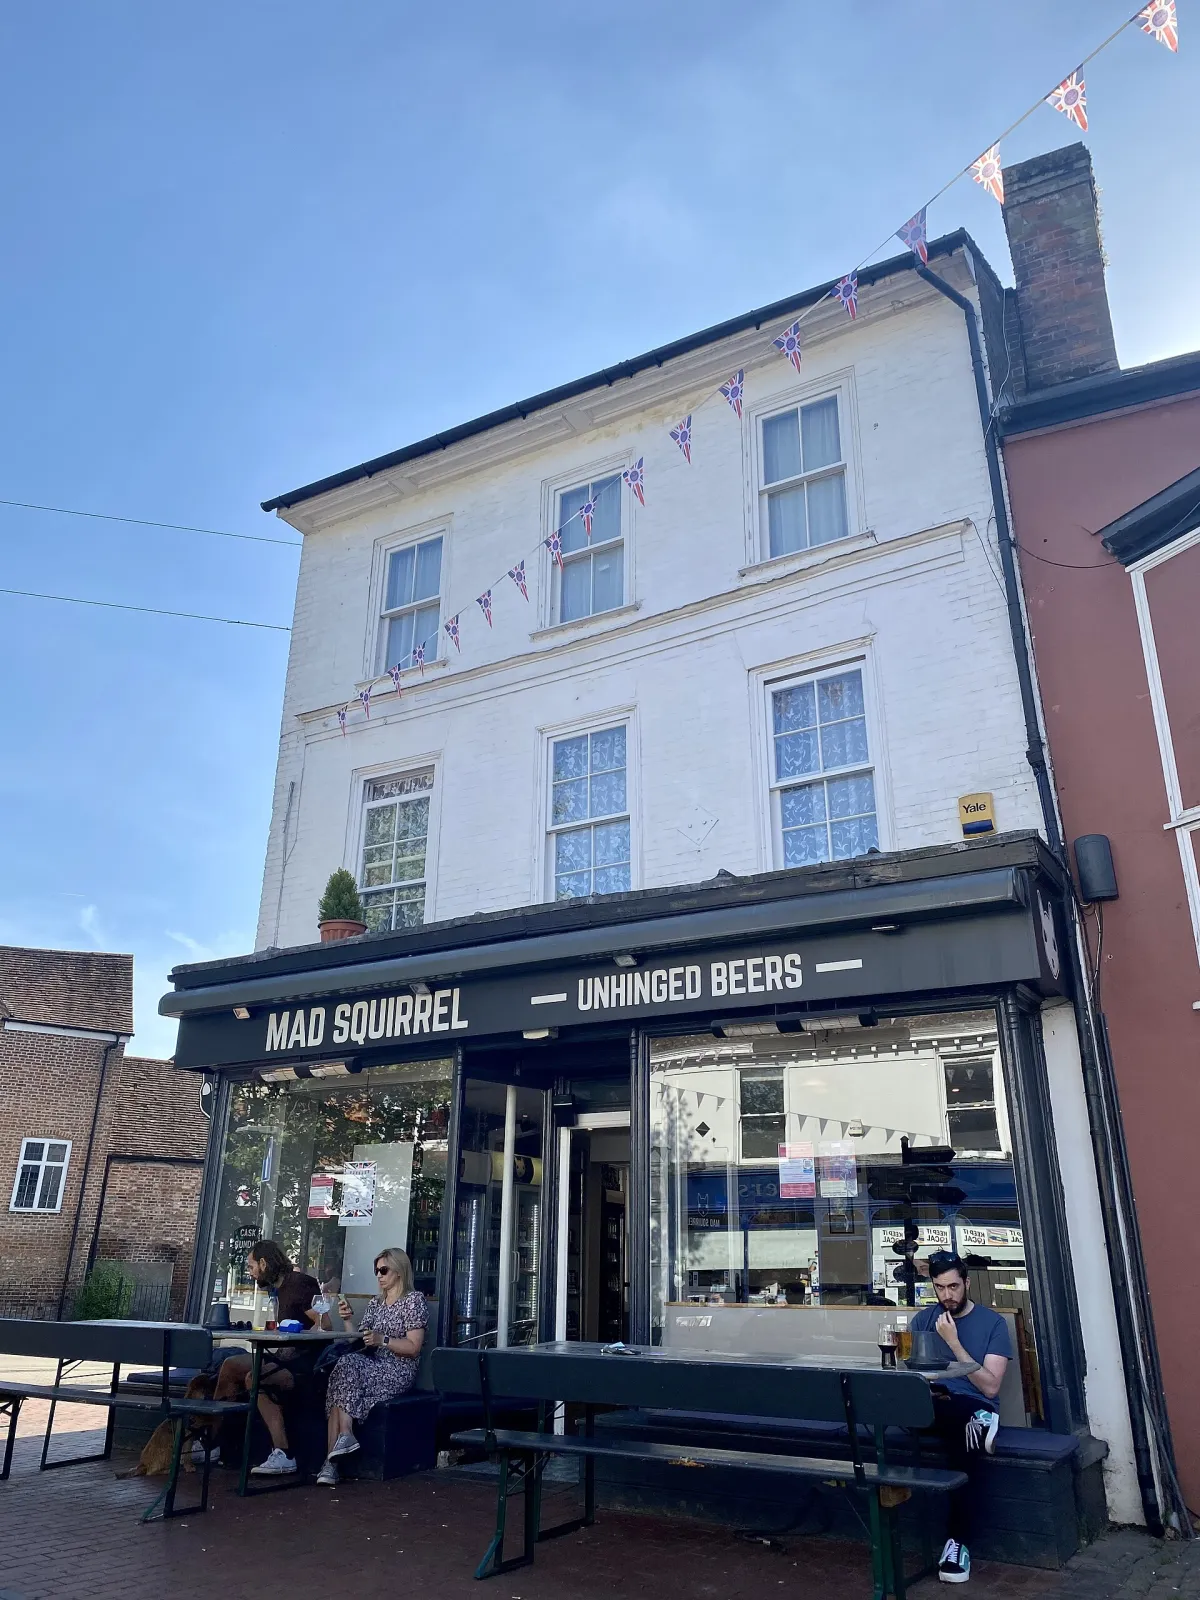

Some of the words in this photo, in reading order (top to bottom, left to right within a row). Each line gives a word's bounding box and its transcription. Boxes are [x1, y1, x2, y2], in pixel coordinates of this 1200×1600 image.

[963, 803, 986, 813] Yale
[577, 965, 702, 1011] UNHINGED
[710, 953, 803, 997] BEERS
[265, 1007, 326, 1052] MAD
[332, 987, 469, 1045] SQUIRREL
[240, 1228, 257, 1237] CASK
